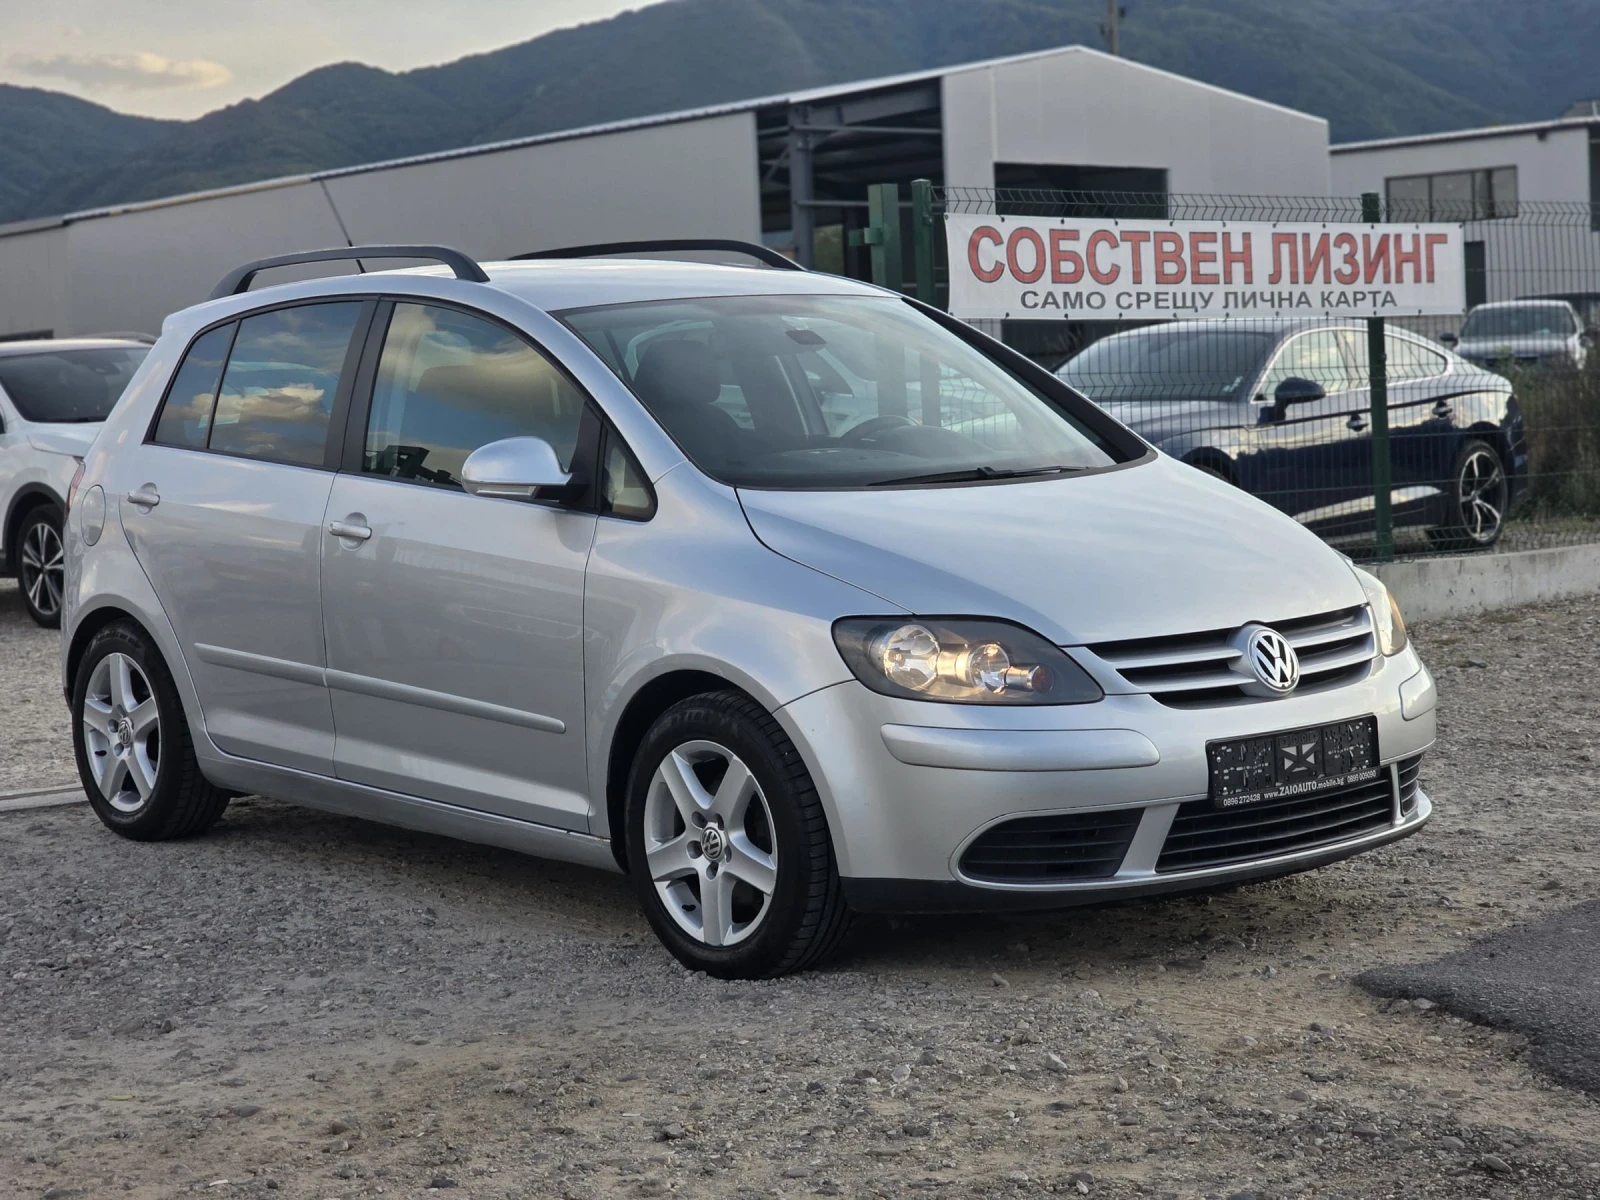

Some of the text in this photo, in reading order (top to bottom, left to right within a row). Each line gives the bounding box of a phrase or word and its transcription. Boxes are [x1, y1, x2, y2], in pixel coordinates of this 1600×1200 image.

[967, 225, 1448, 286] СОБСТВЕН ЛИЗИНГ
[1020, 290, 1398, 312] САМО СРЕЩУ ЛИЧНА КАРТА
